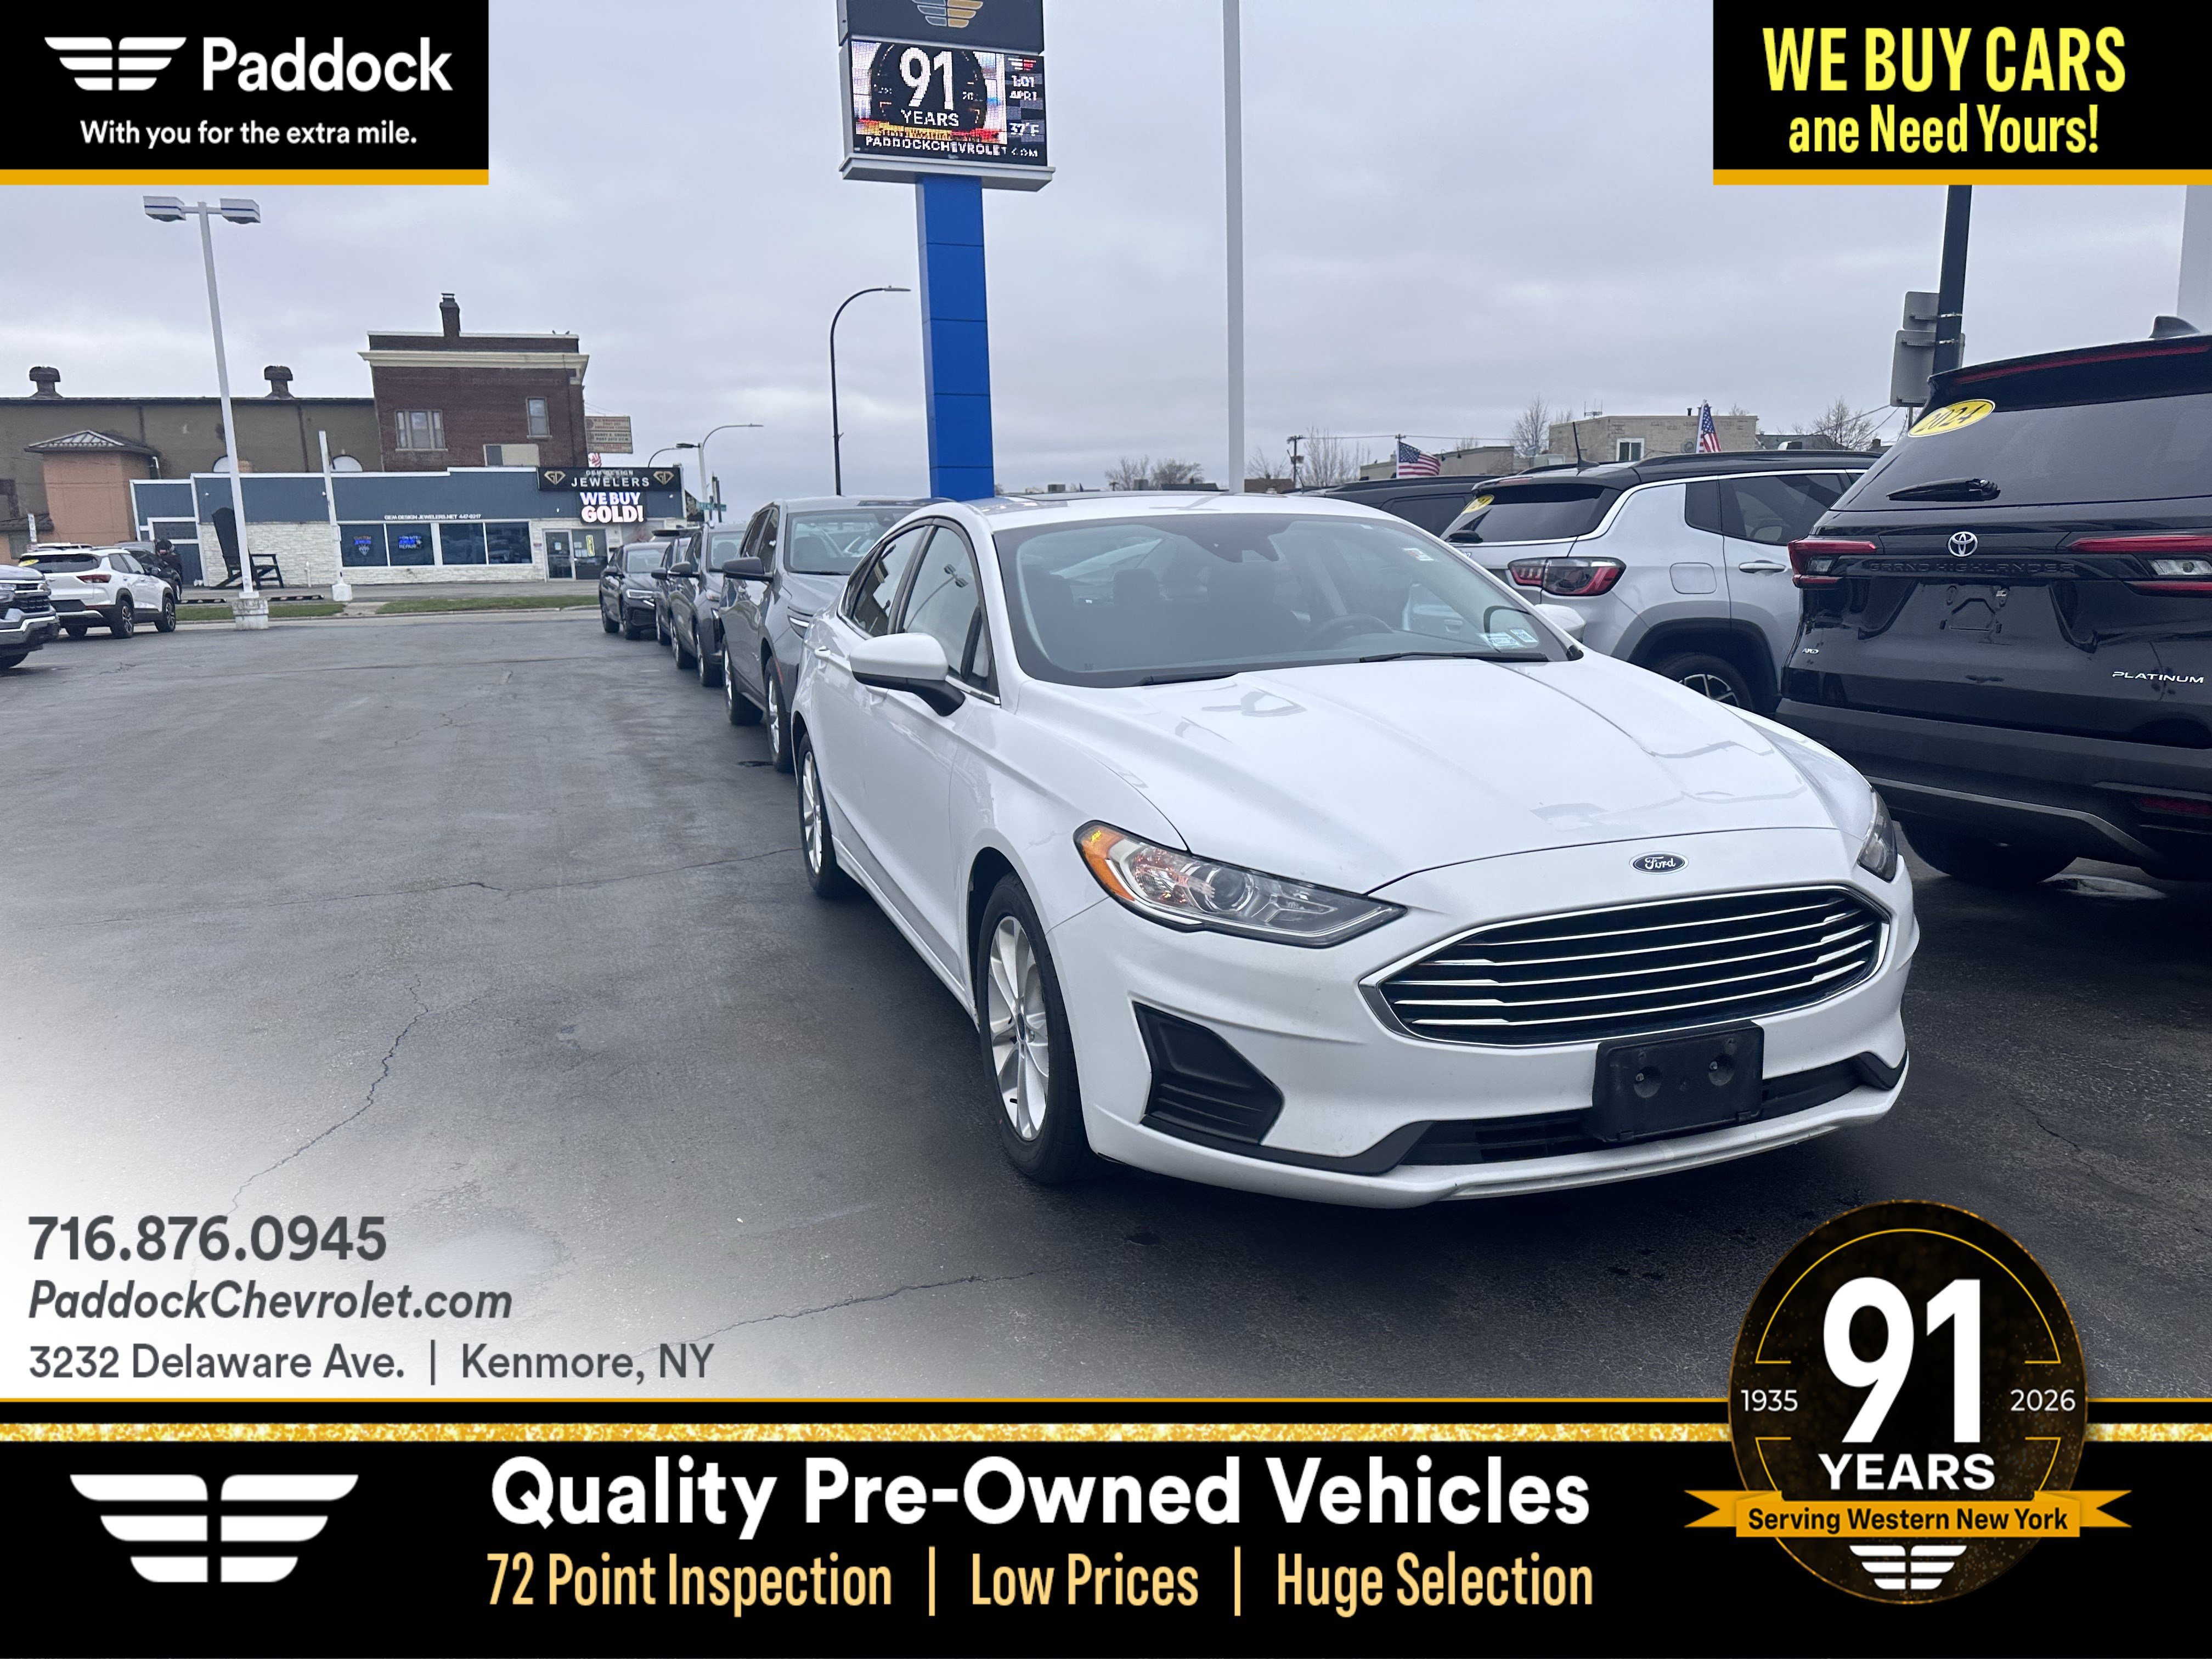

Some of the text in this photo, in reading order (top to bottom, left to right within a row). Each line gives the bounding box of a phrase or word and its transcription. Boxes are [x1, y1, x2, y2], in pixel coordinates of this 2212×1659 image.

[900, 47, 953, 111] 91
[901, 109, 959, 127] YEARS
[571, 477, 650, 487] JEWELERS
[580, 492, 640, 505] WE BUY
[582, 505, 644, 523] GOLD!
[1937, 563, 2076, 573] HIGHLANDER
[2112, 671, 2204, 684] PLATINUM
[1645, 856, 1676, 870] Ford
